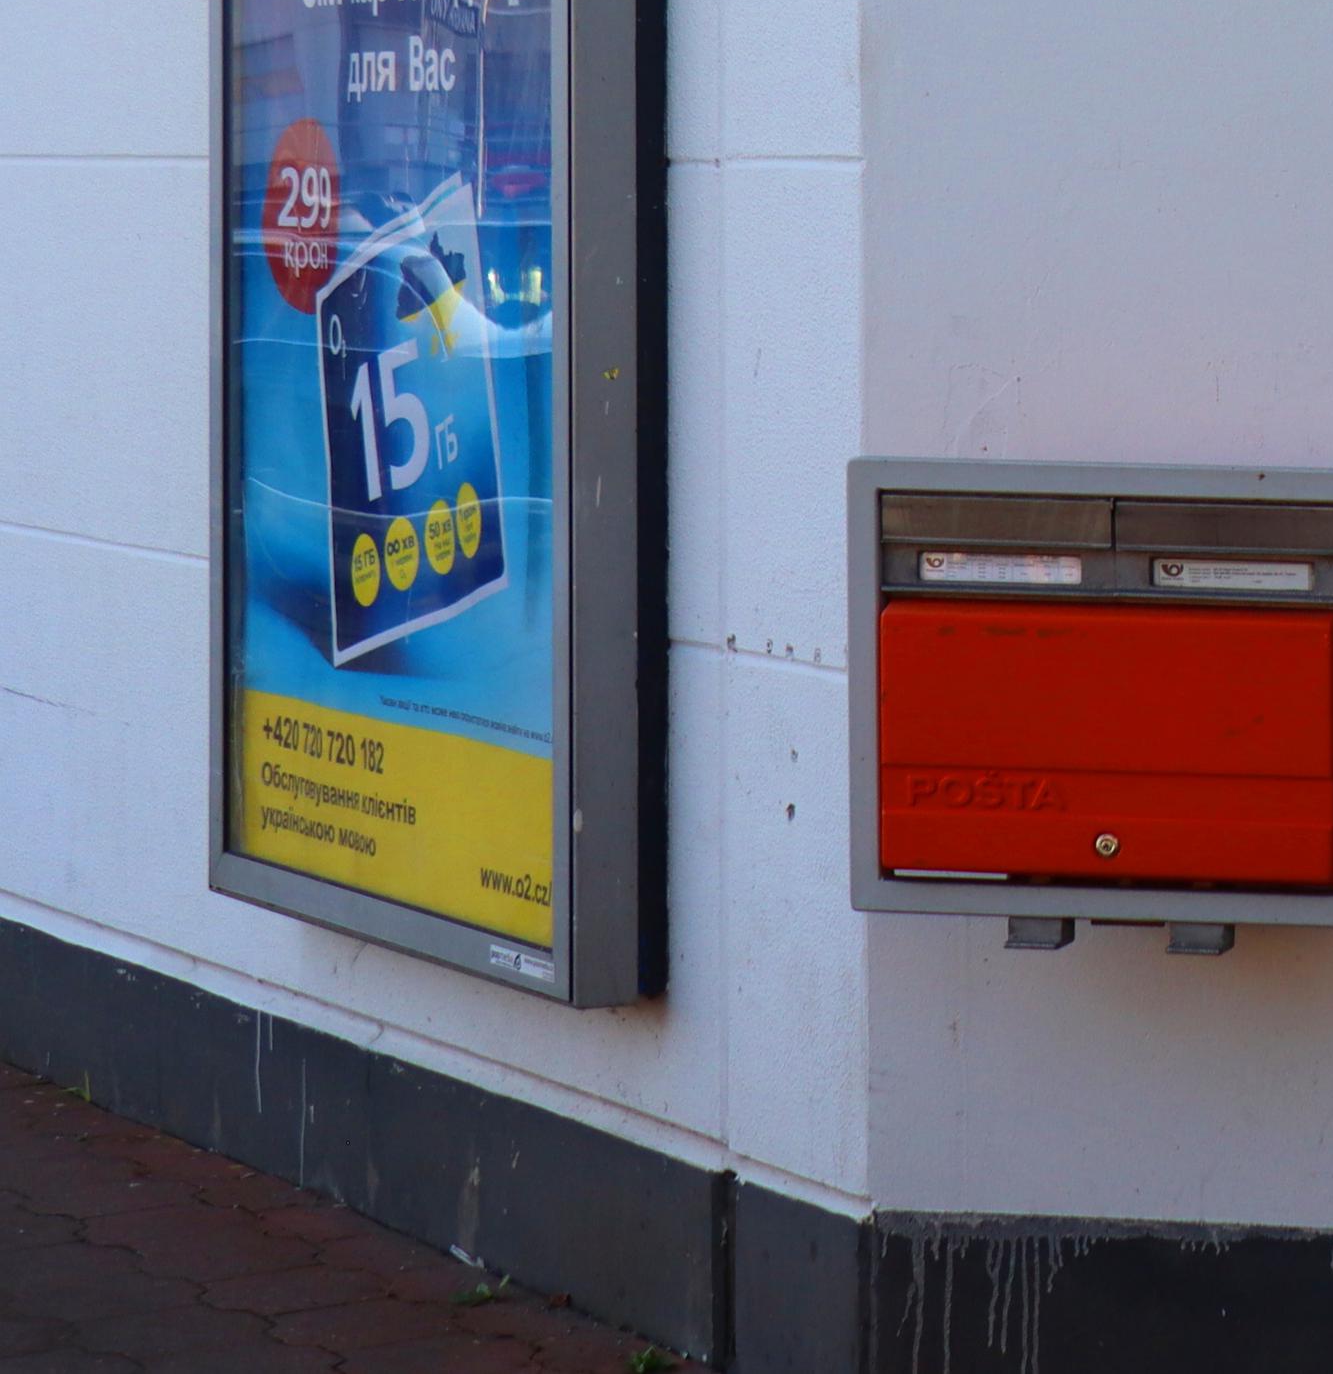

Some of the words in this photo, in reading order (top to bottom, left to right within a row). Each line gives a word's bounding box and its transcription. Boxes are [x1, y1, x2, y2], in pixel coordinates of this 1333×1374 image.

[347, 51, 396, 102] для
[409, 35, 456, 92] Вас
[277, 166, 331, 229] 299
[284, 241, 328, 278] крон
[350, 338, 430, 502] 15
[434, 414, 459, 471] ГБ
[263, 716, 300, 751] +420
[303, 722, 323, 759] 720
[327, 730, 356, 767] 720
[360, 738, 384, 774] 182
[261, 761, 360, 811] Обслуговування
[361, 792, 417, 826] клієнтів
[905, 771, 1066, 813] POŠTA
[261, 805, 335, 843] українською
[338, 827, 376, 857] мовою
